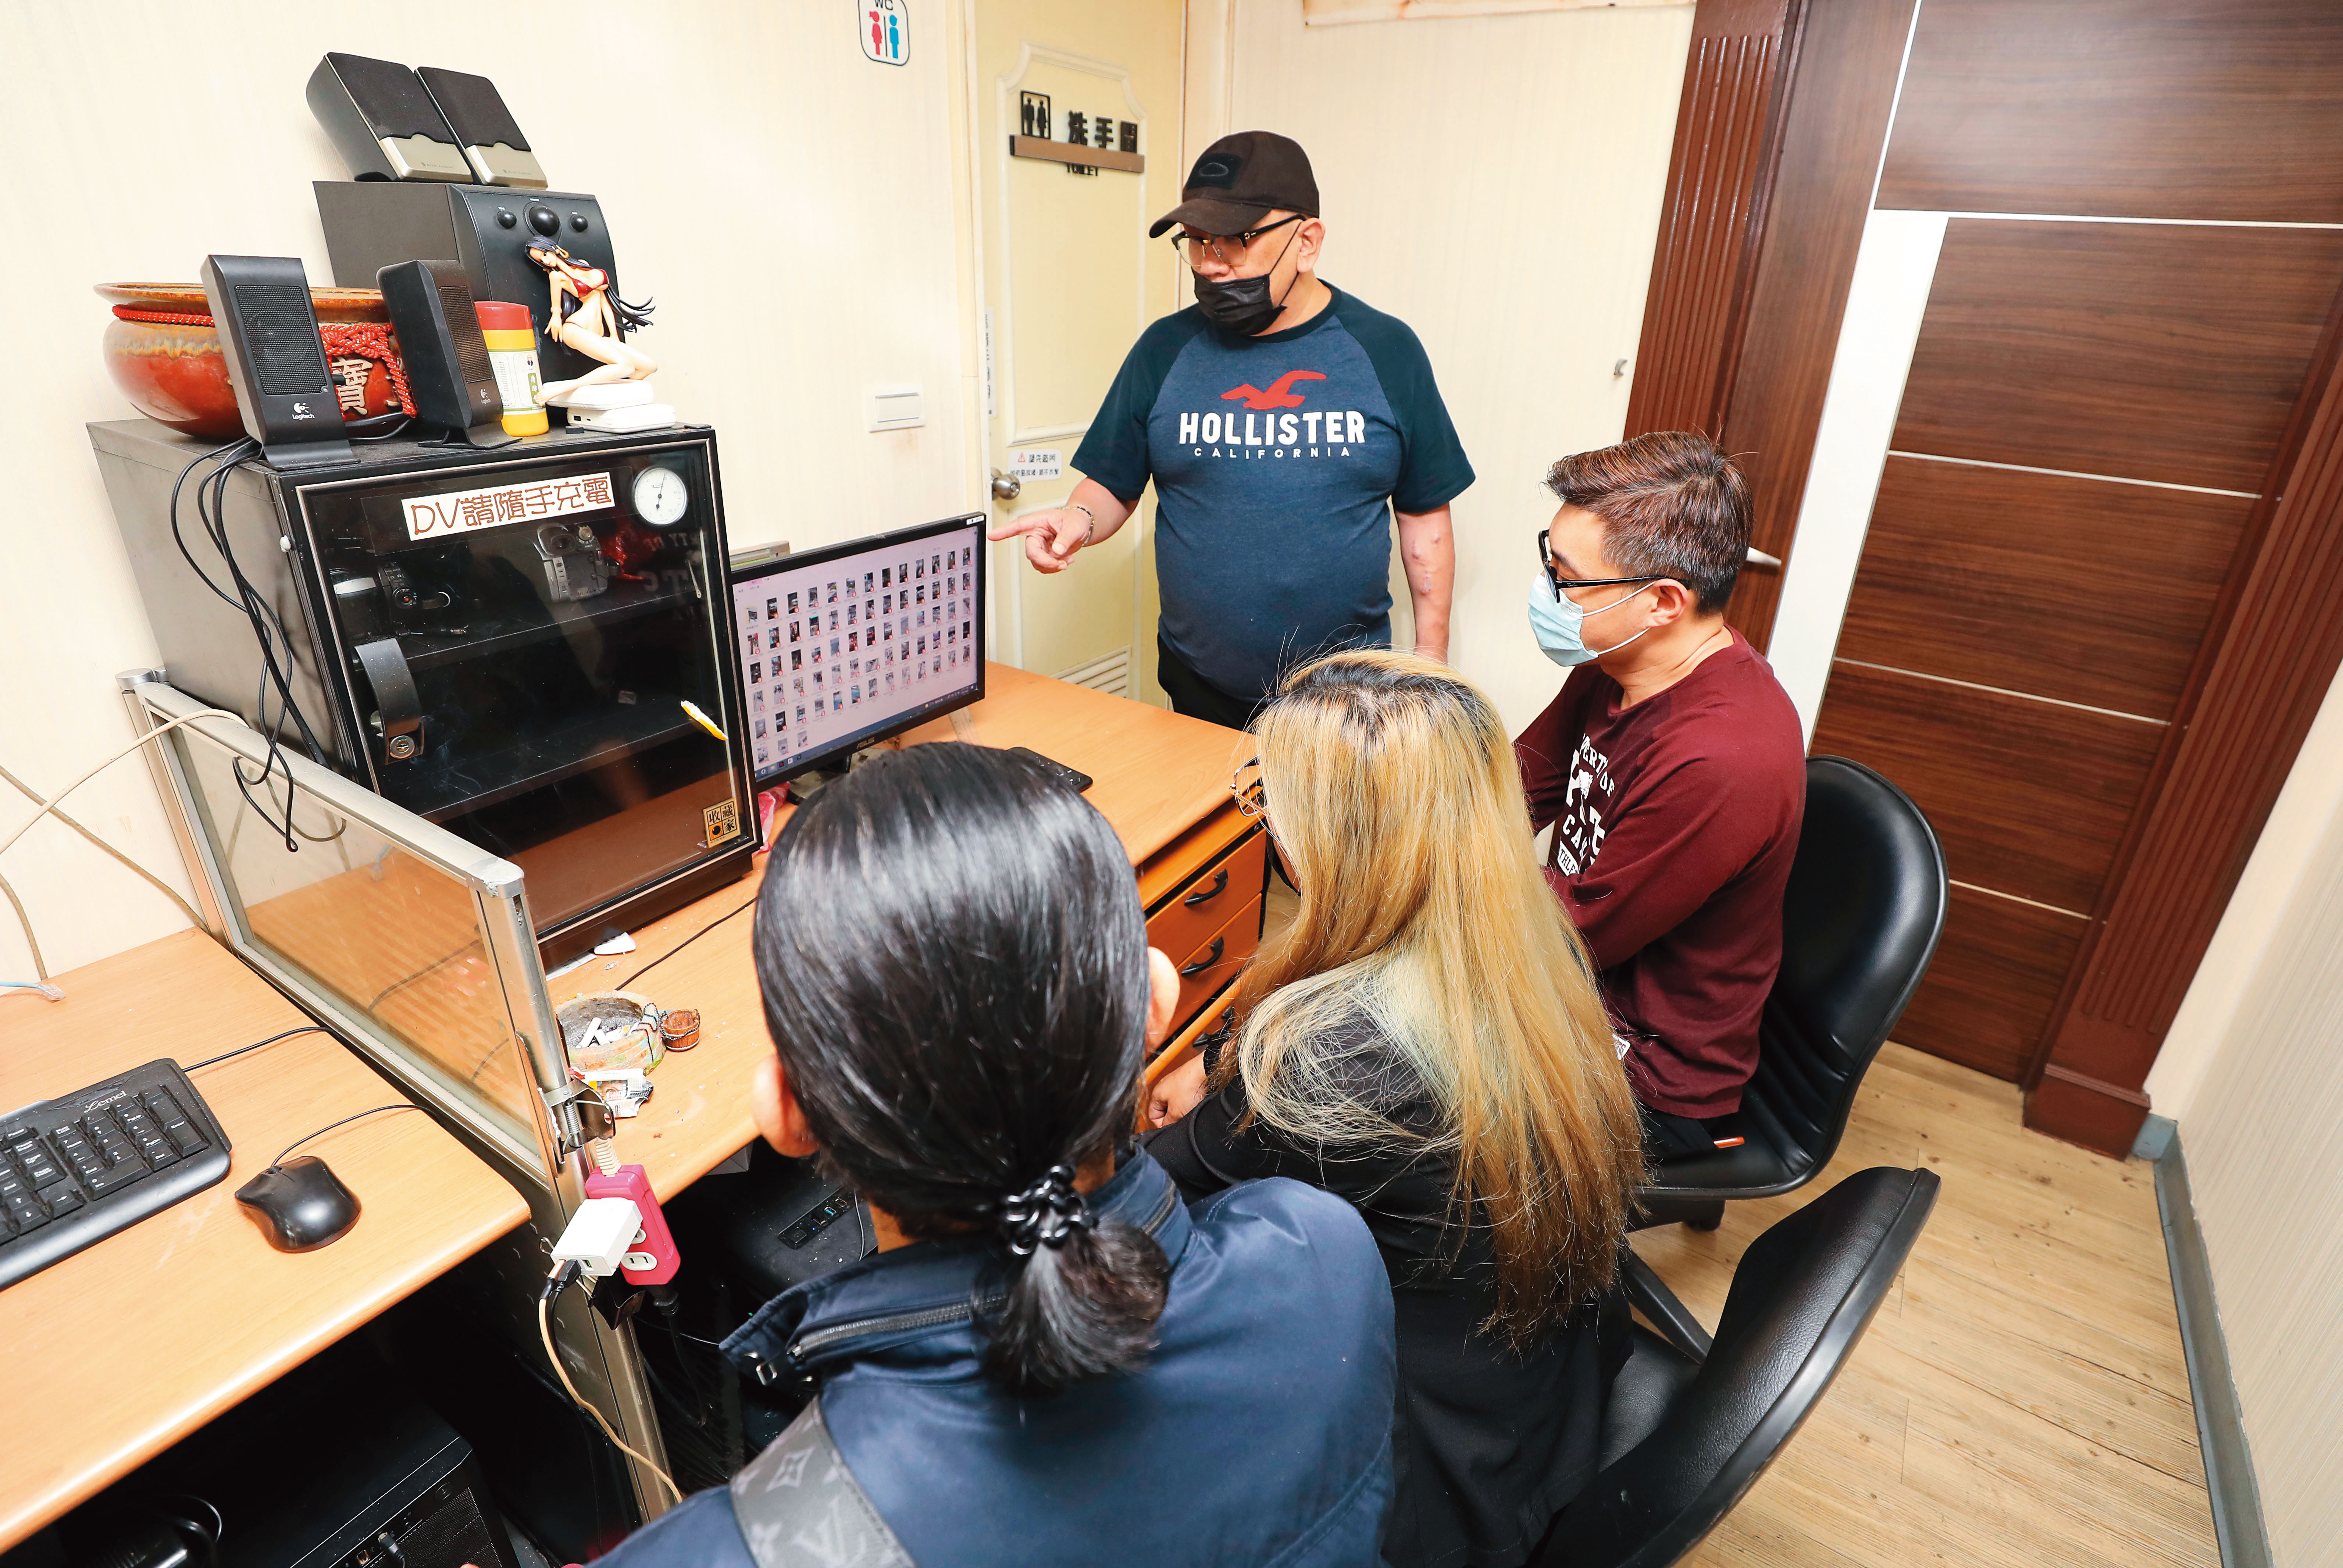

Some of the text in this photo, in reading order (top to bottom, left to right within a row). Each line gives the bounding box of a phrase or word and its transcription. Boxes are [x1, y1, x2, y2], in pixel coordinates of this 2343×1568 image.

[874, 0, 893, 10] WC
[1068, 110, 1138, 153] 洗手間
[1179, 410, 1366, 446] HOLLISTER
[1194, 446, 1350, 459] CALIFORNIA
[411, 476, 611, 535] DV請隨手充電
[83, 1090, 128, 1113] Lemel
